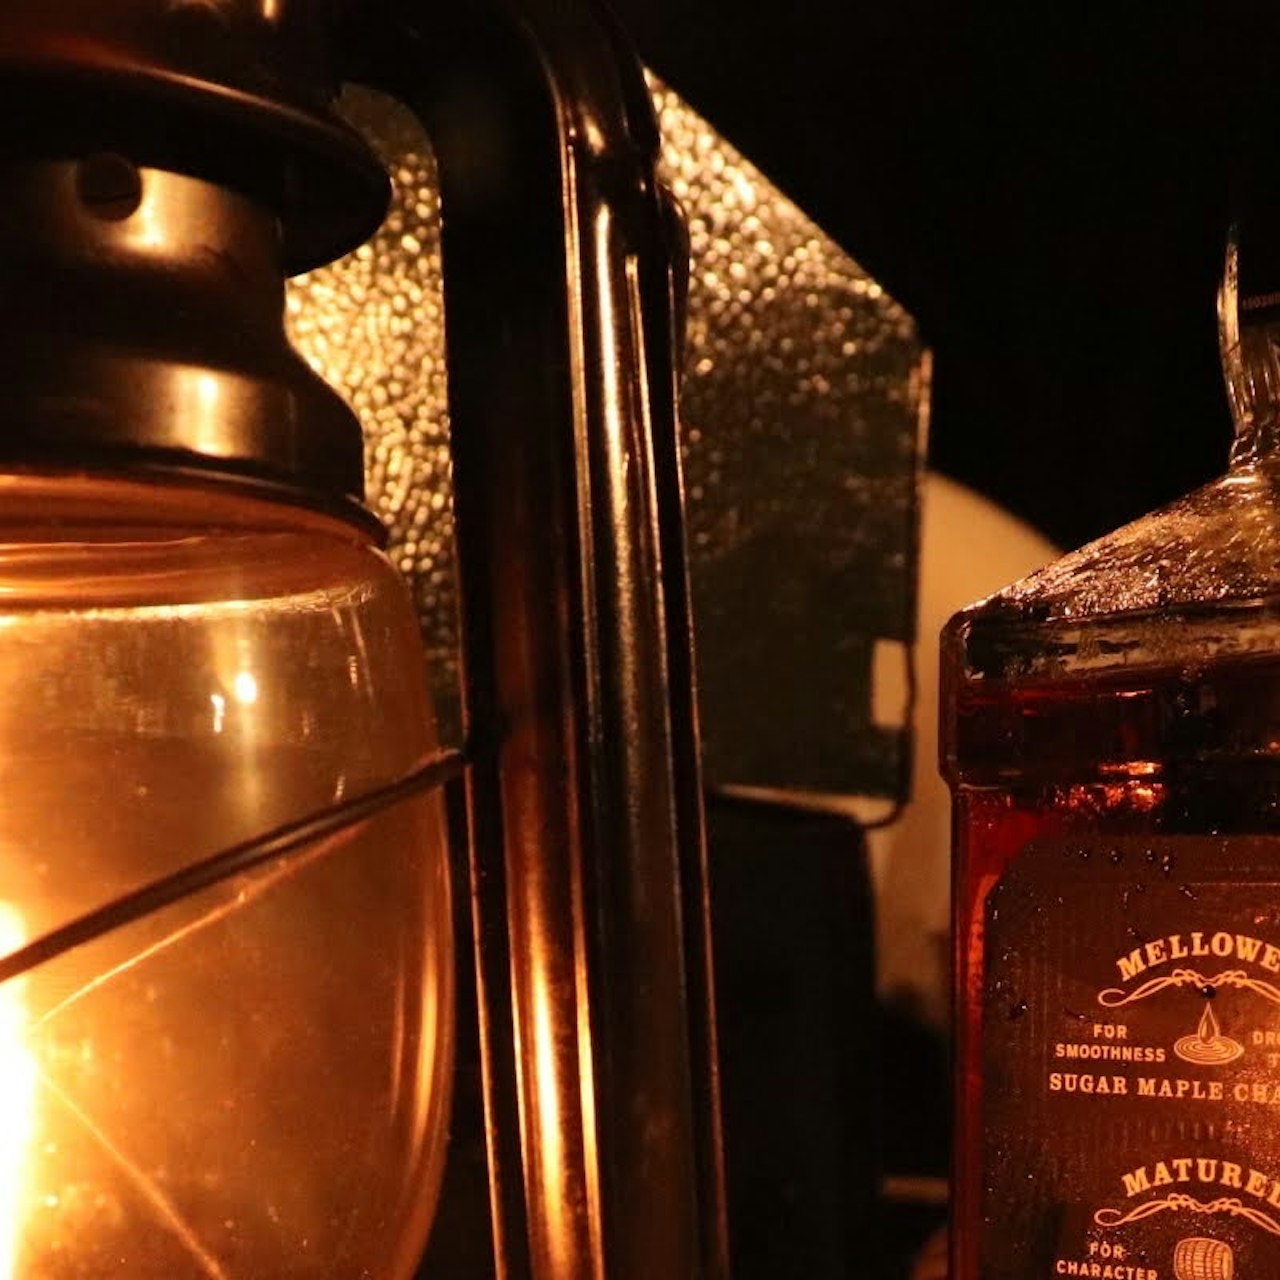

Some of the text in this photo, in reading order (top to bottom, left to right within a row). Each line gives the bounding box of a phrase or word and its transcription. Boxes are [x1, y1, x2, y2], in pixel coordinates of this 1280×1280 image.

[1093, 1023, 1128, 1039] FOR
[1055, 1043, 1166, 1063] SMOOTHNESS
[1049, 1073, 1128, 1096] SUGAR
[1138, 1076, 1224, 1101] MAPLE
[1089, 1242, 1123, 1259] FOR
